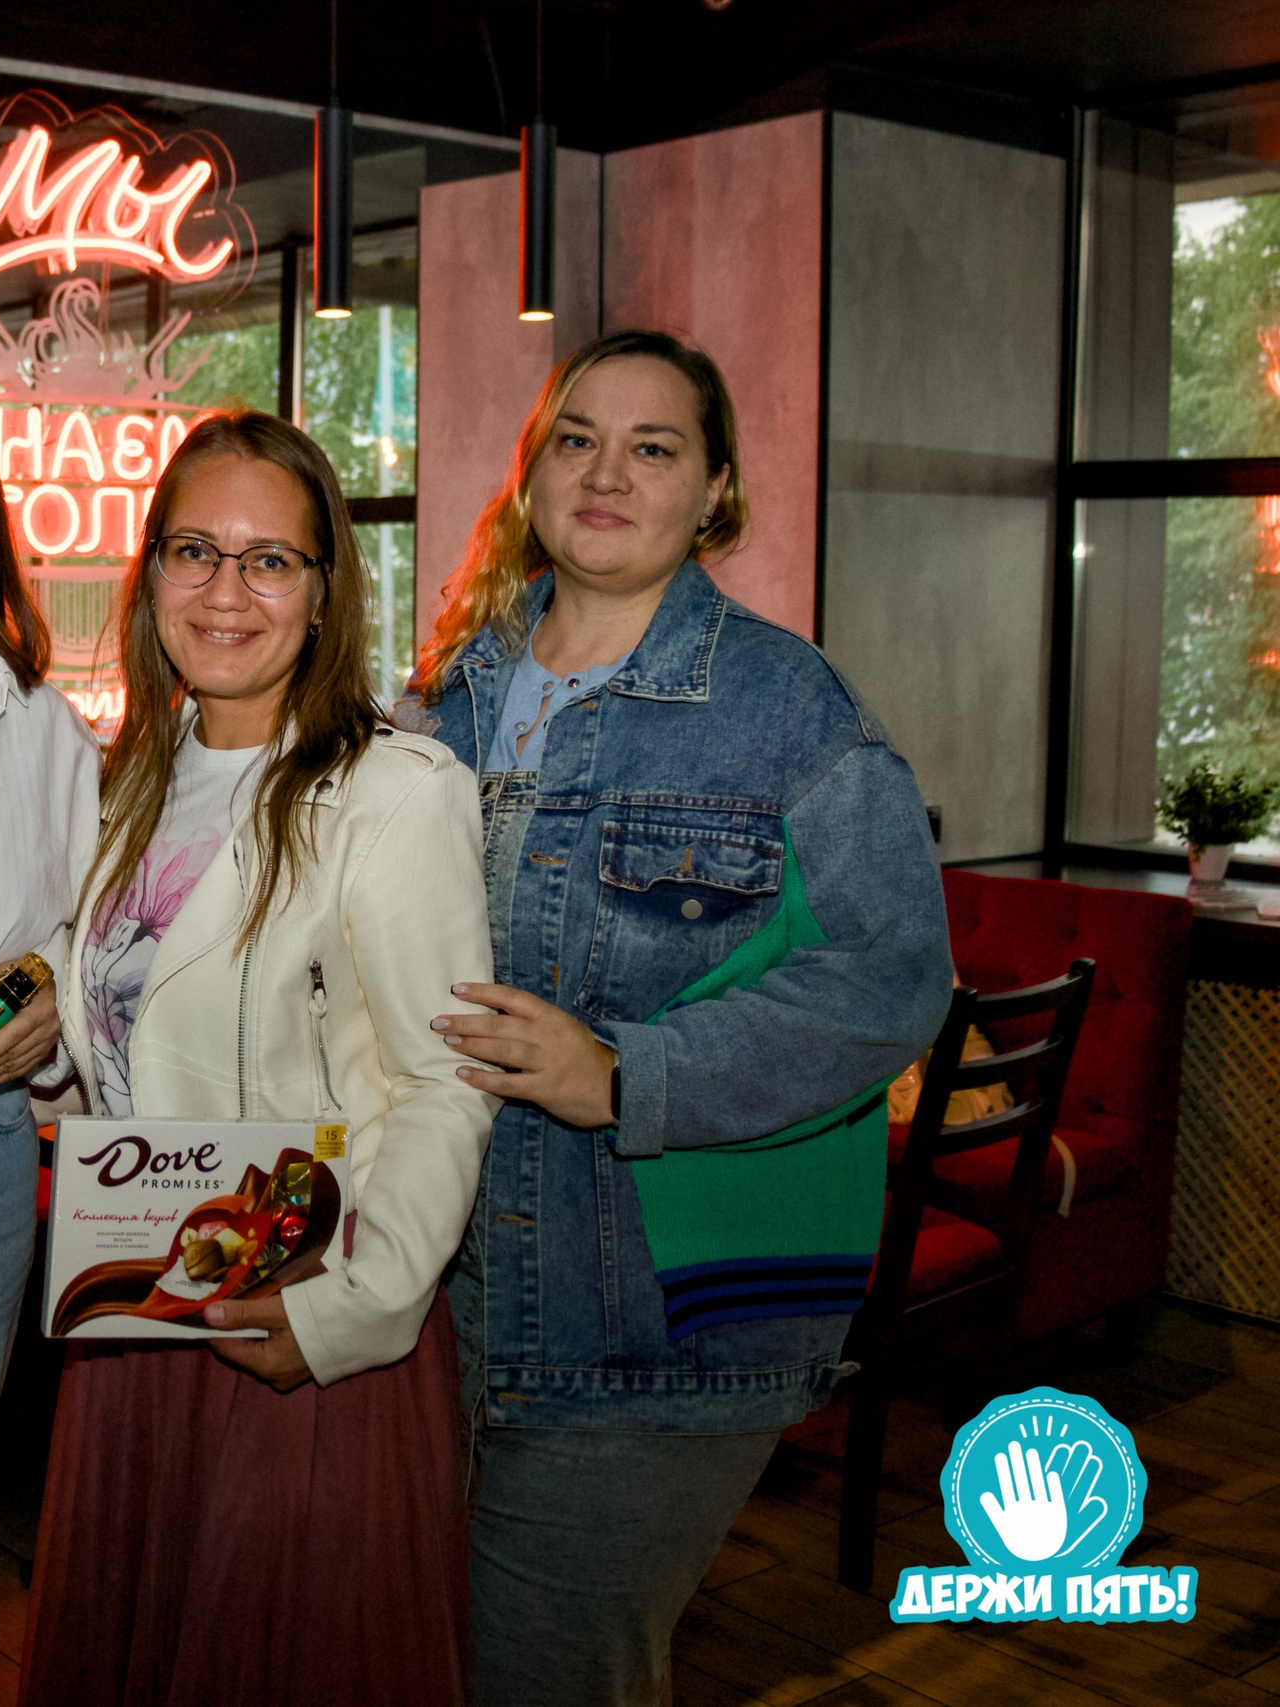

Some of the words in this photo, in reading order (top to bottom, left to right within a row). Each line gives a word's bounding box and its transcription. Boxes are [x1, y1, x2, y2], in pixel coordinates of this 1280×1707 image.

[324, 1130, 338, 1141] 15
[78, 1135, 223, 1188] Dove
[141, 1178, 221, 1189] PROMISES
[72, 1208, 140, 1224] Коллекция
[143, 1208, 180, 1227] вкусов
